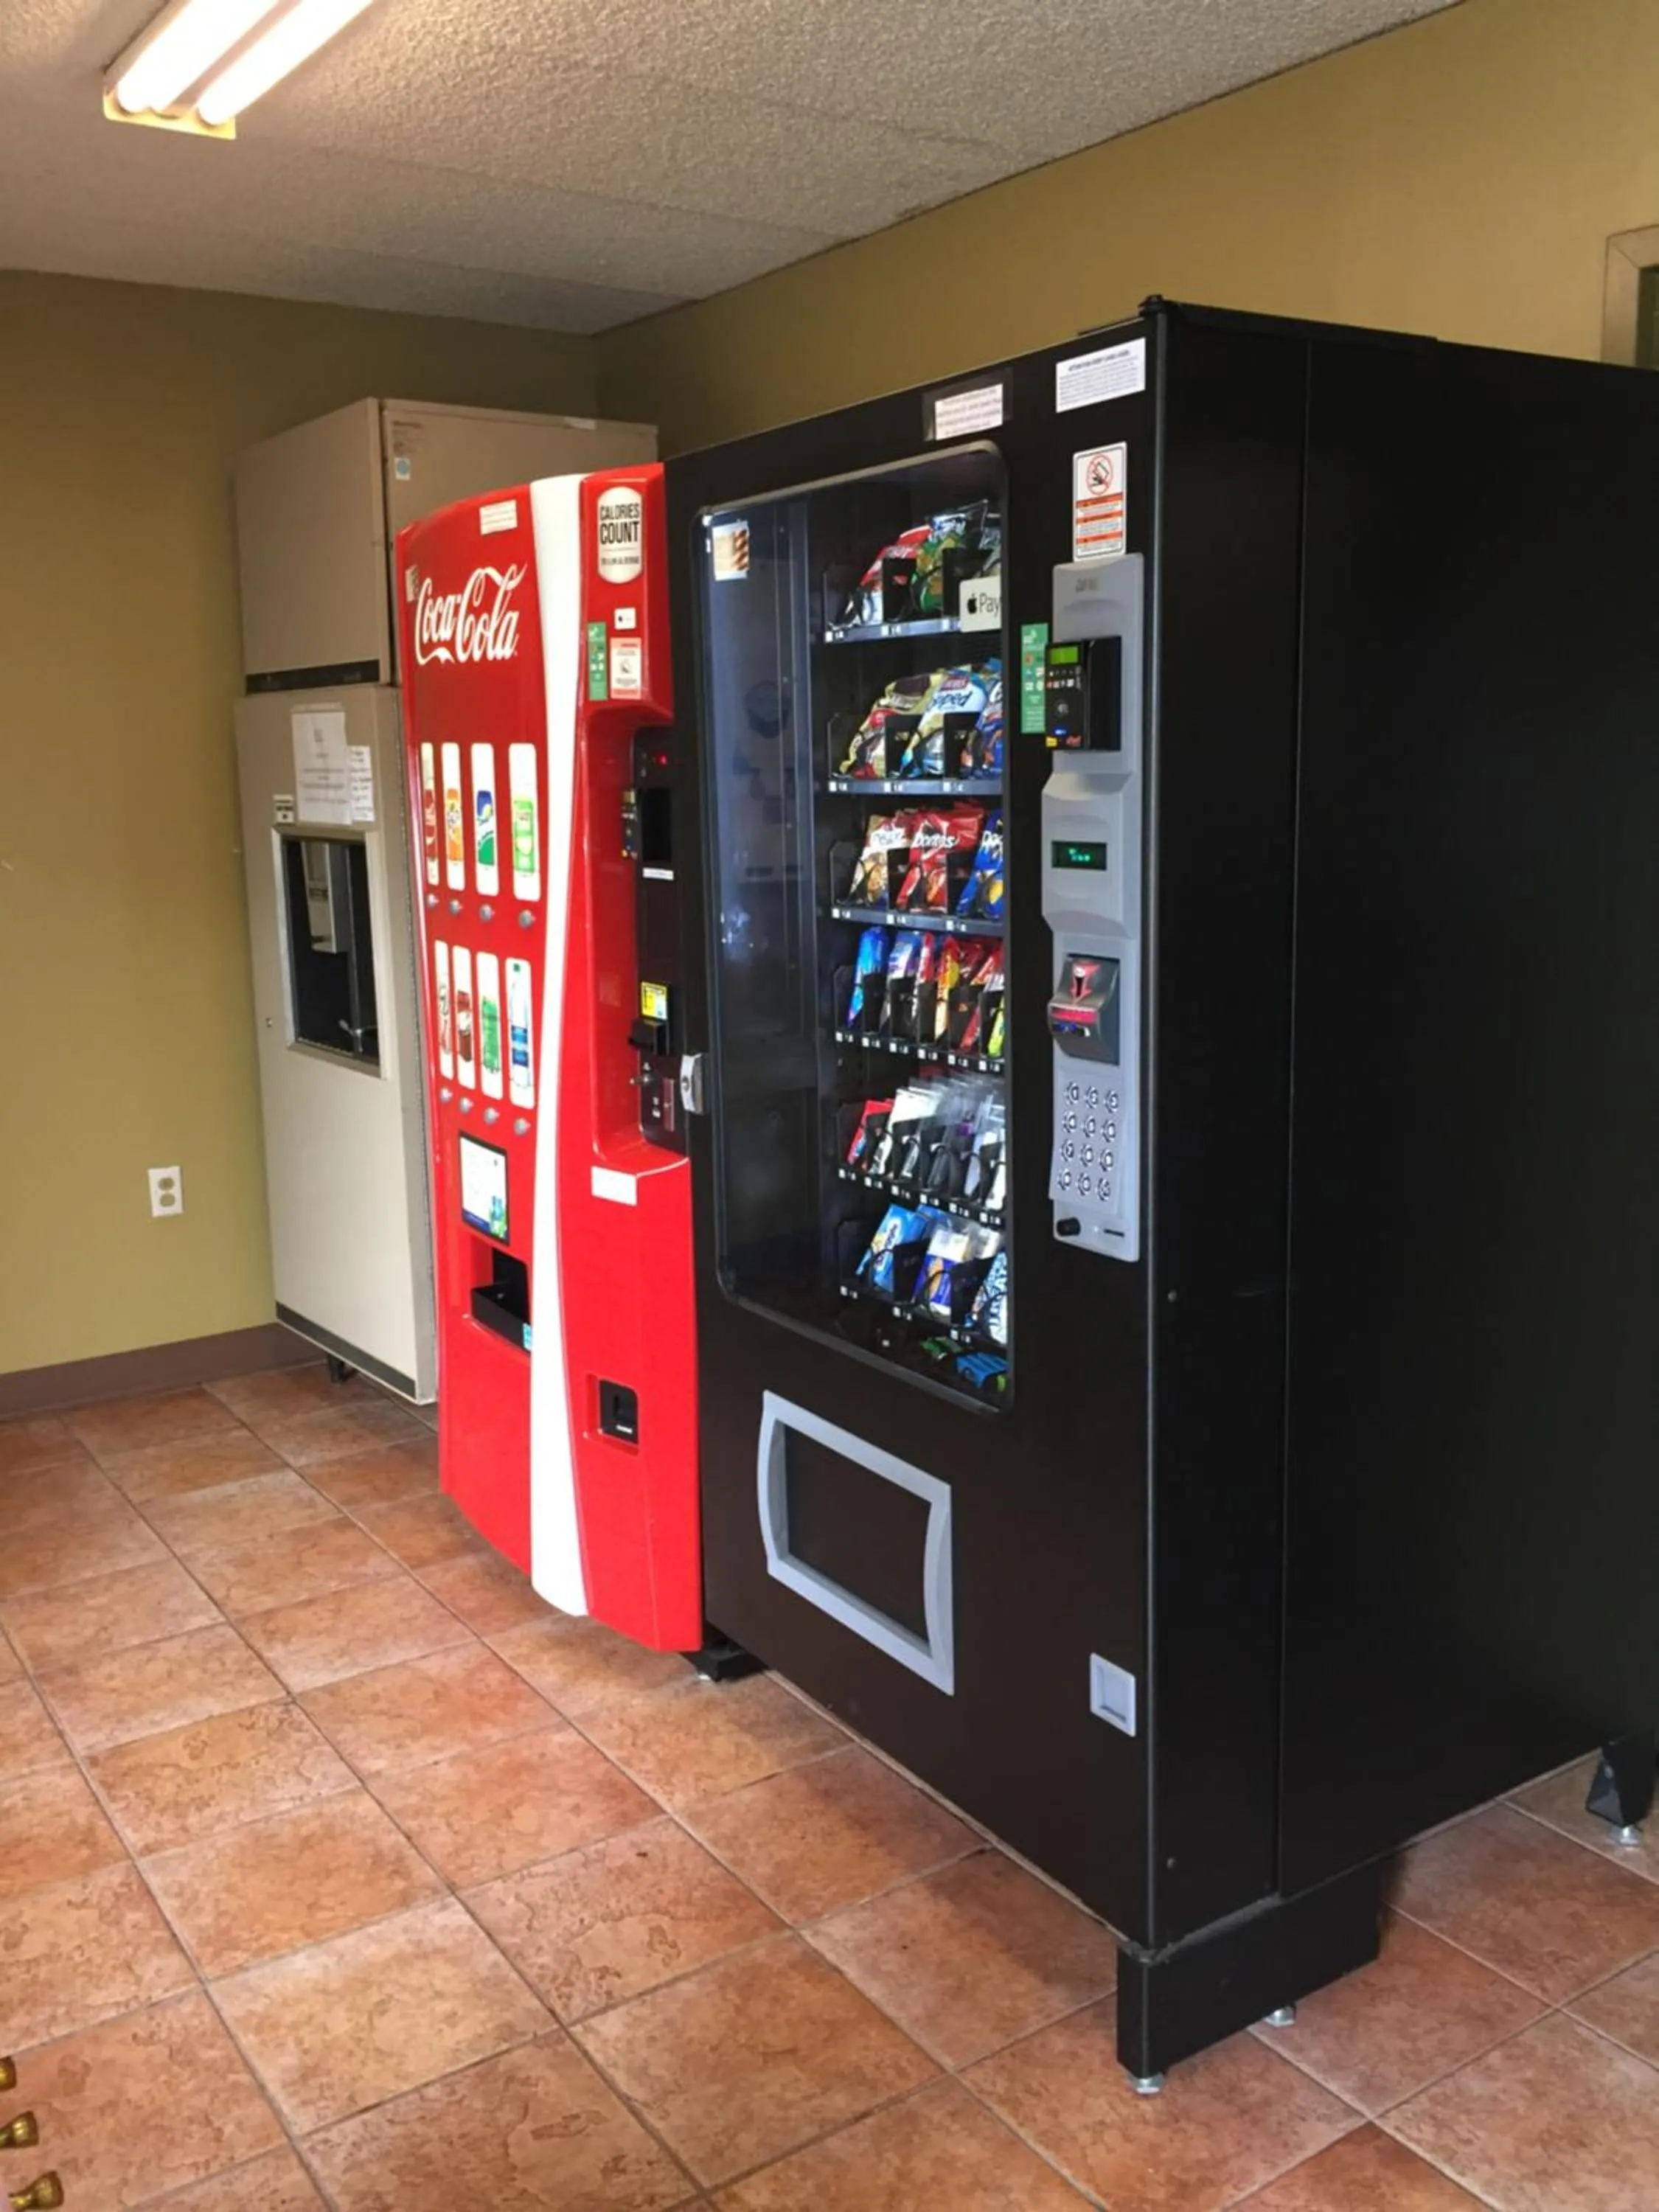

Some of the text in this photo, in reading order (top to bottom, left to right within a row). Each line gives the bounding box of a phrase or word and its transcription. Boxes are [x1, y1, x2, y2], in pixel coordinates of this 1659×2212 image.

[600, 503, 639, 521] CALORIES
[599, 521, 639, 544] COUNT
[415, 562, 527, 665] Coca-Cola
[979, 592, 999, 618] Pay
